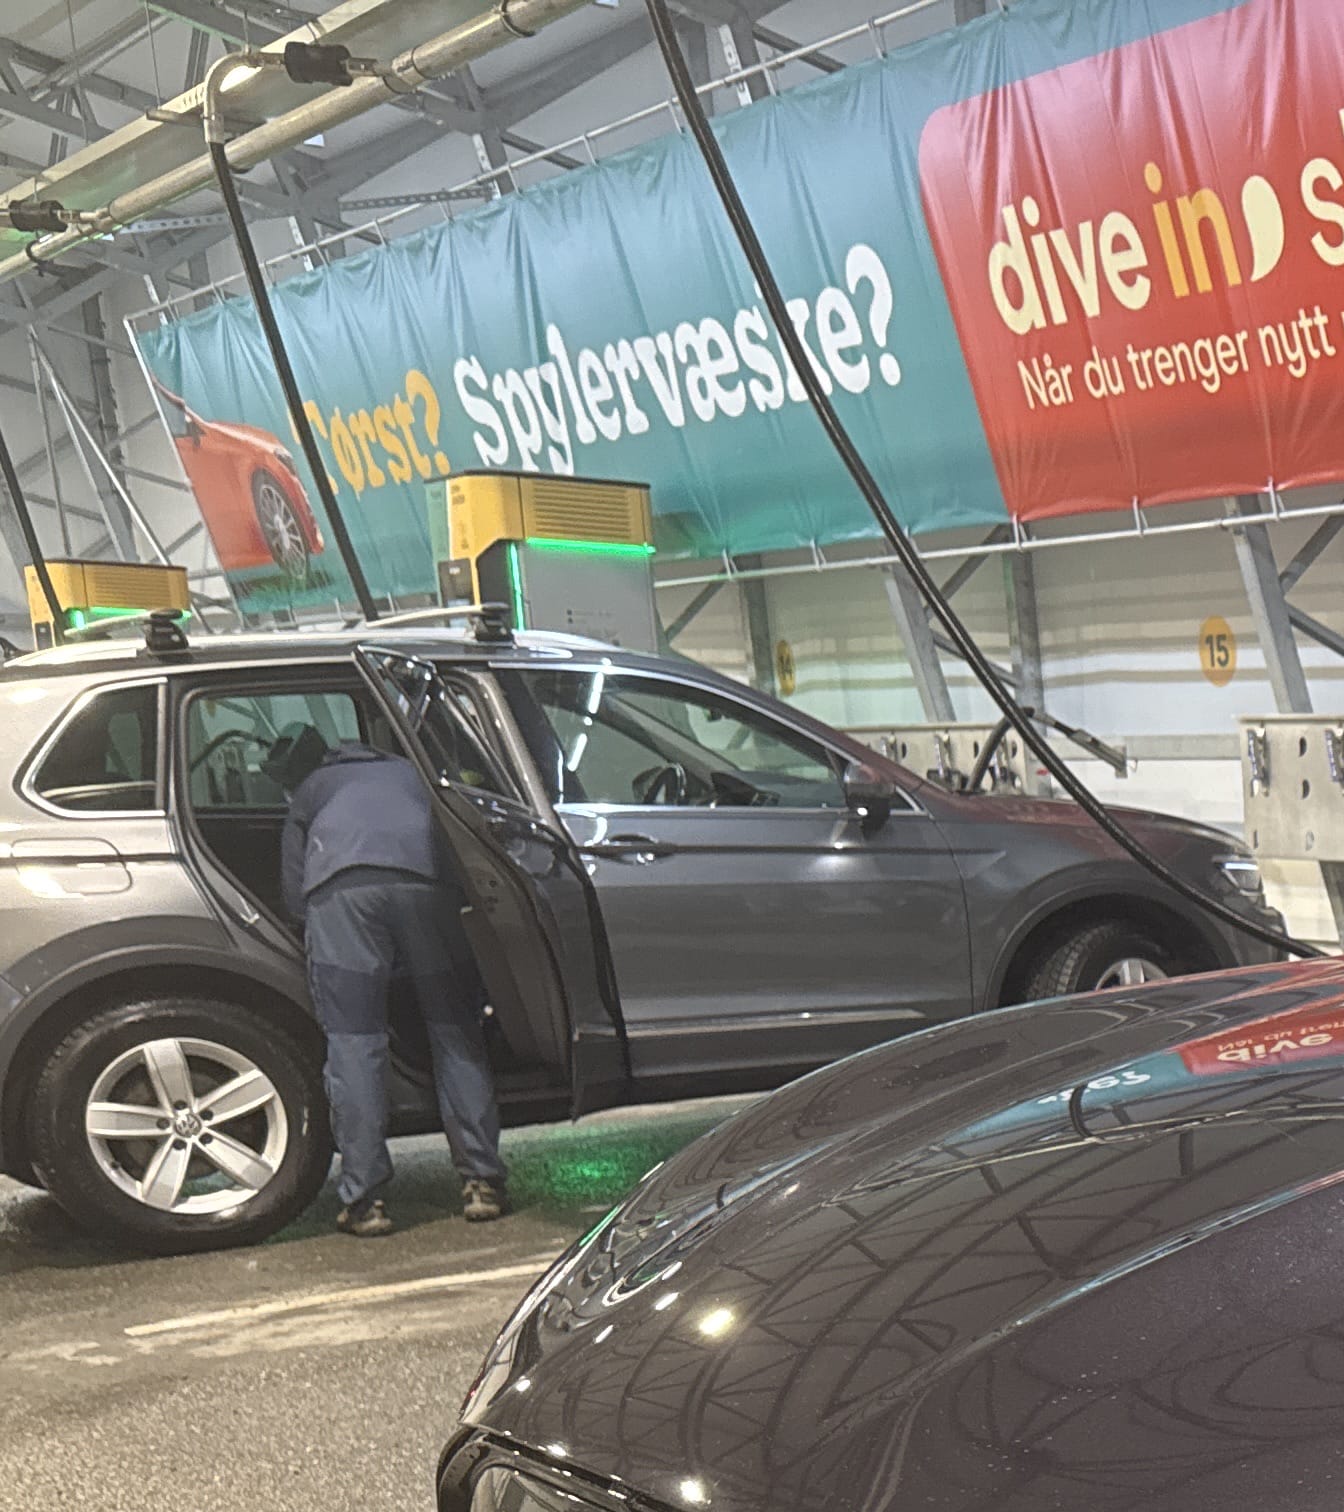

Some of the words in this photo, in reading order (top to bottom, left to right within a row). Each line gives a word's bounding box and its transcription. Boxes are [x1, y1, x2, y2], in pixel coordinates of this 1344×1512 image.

[988, 195, 1152, 335] dive
[1144, 161, 1243, 299] in
[1016, 353, 1074, 410] Når
[1083, 345, 1126, 400] du
[1126, 330, 1249, 394] trenger
[1257, 305, 1336, 378] nytt
[1205, 633, 1230, 668] 15
